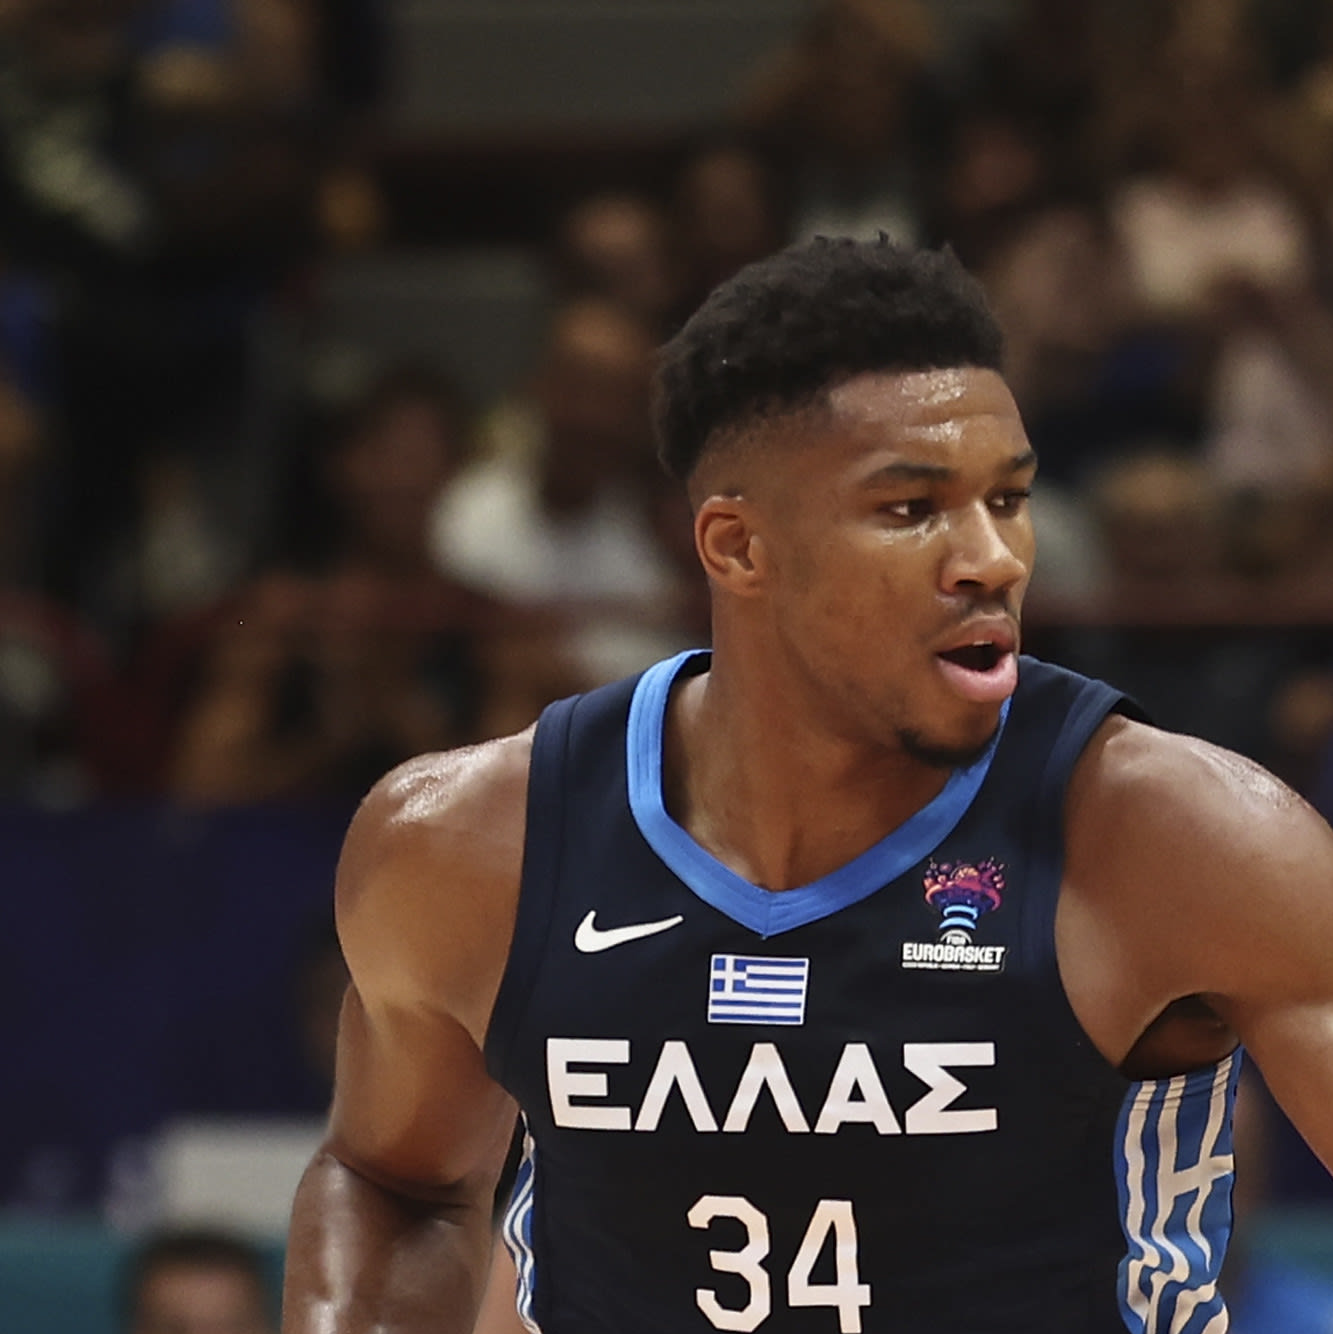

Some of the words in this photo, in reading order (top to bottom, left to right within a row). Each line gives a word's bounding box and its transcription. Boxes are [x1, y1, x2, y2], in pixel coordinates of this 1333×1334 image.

[903, 943, 1005, 963] EUROBASKET
[547, 1038, 997, 1134] ΕΛΛΑΣ
[688, 1196, 870, 1334] 34
